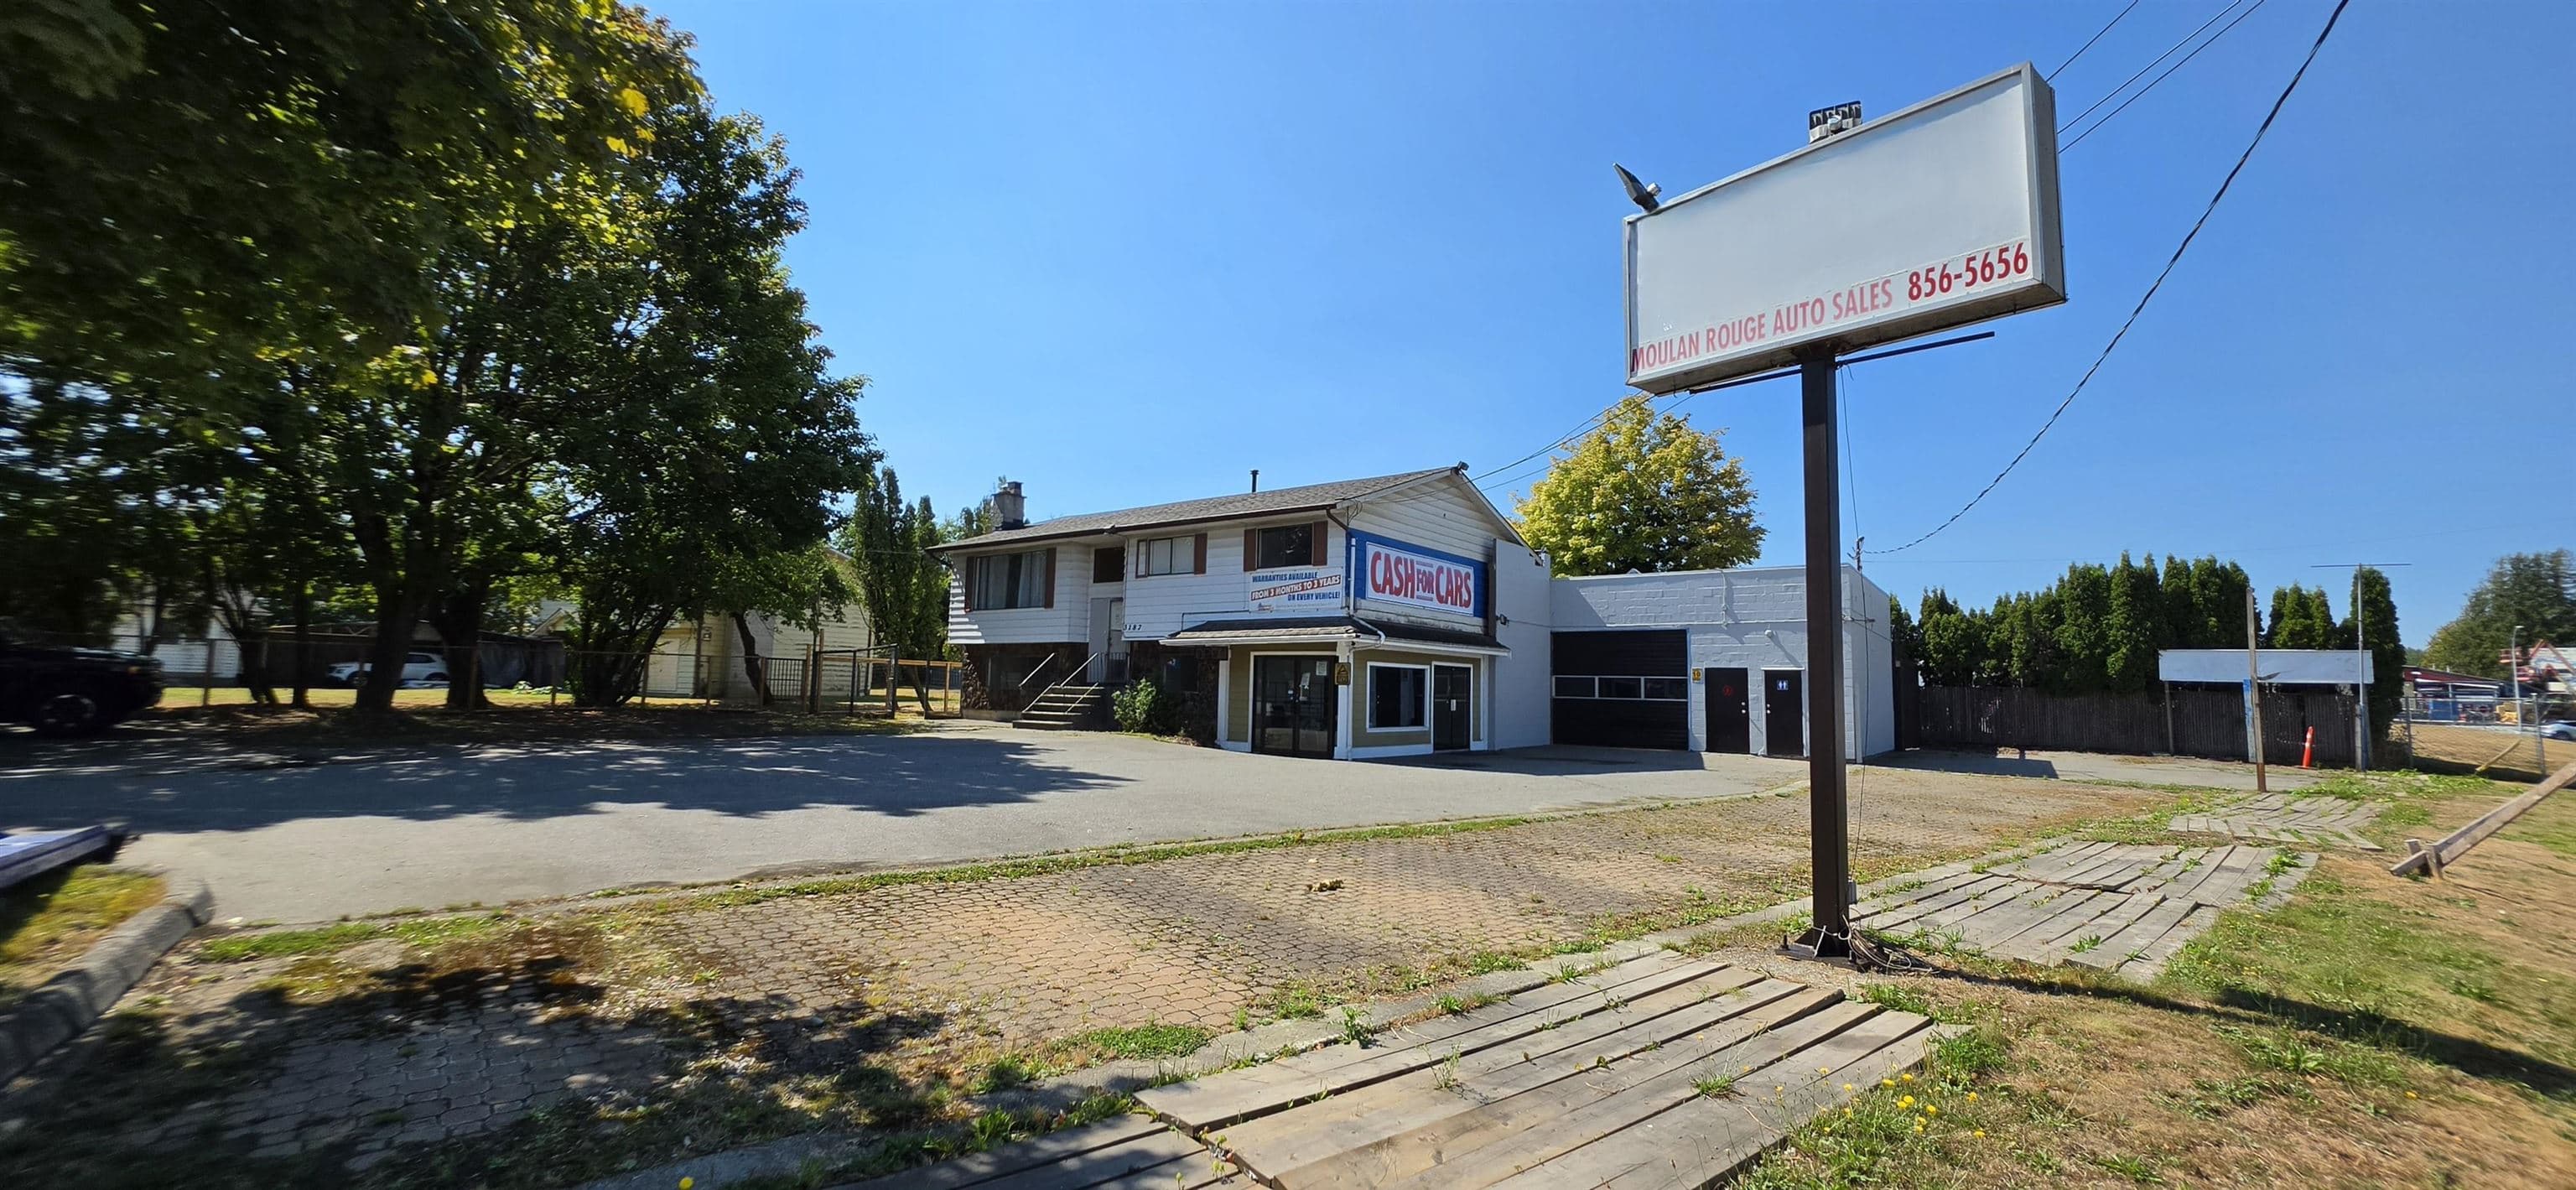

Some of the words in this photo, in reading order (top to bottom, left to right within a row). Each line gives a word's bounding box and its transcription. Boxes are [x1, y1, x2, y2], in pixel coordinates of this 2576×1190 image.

[1909, 242, 2028, 301] 856-5656
[1631, 331, 1700, 372] MOULAN
[1706, 313, 1765, 353] ROUGE
[1773, 297, 1825, 336] AUTO
[1832, 278, 1893, 320] SALES
[1252, 573, 1288, 582] WARRANTIES
[1288, 571, 1317, 580] AVAILABLE
[1252, 589, 1269, 600] FROM
[1270, 588, 1275, 596] 3
[1275, 584, 1302, 595] MONTHS
[1303, 581, 1312, 590] TO
[1313, 580, 1318, 589] 3
[1319, 575, 1341, 587] YEARS
[1296, 592, 1313, 600] EVERY
[1370, 551, 1415, 599] CASH
[1415, 568, 1434, 594] FOR
[1435, 565, 1472, 608] CARS
